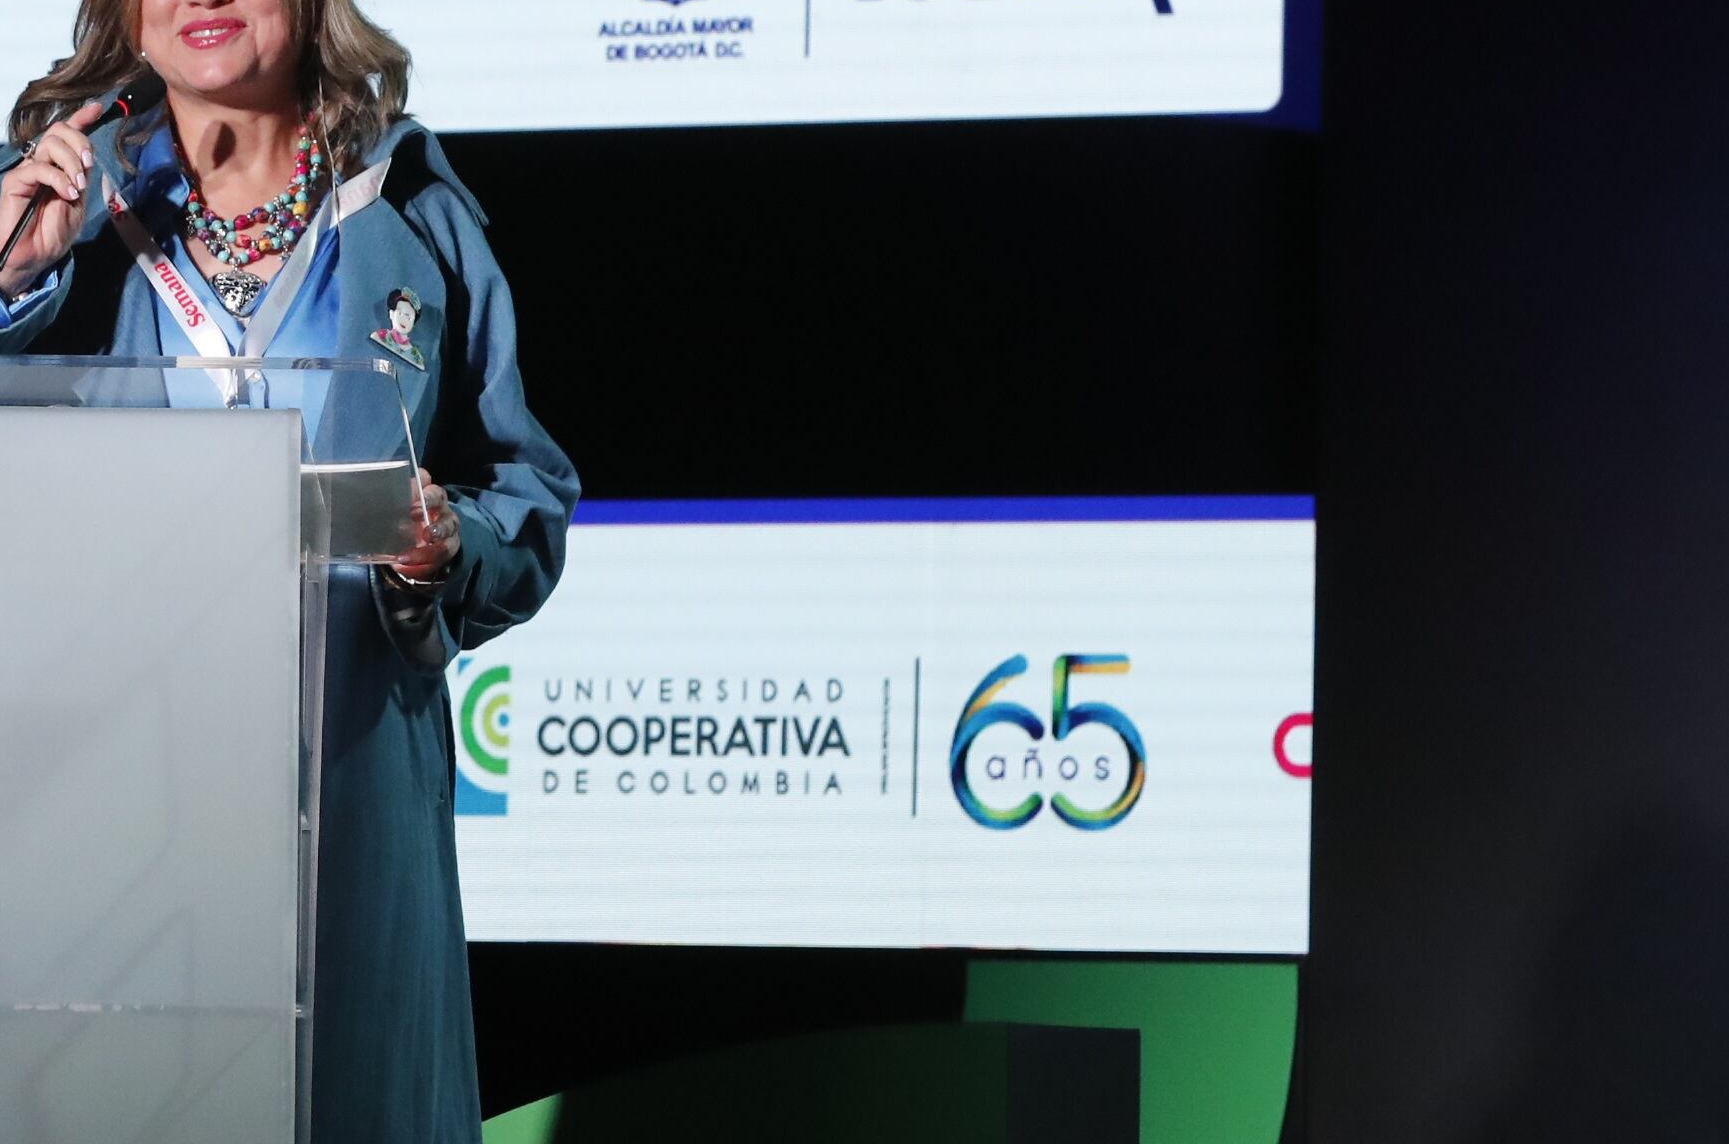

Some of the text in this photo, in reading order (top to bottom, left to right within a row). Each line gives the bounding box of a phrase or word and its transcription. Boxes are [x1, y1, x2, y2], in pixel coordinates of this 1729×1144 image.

[691, 17, 754, 35] MAYOR
[606, 44, 628, 61] DE
[153, 261, 206, 328] Semana
[544, 677, 845, 704] UNIVERSIDAD
[537, 715, 852, 758] COOPERATIVA
[949, 653, 1147, 832] 65
[984, 745, 1111, 783] años
[542, 768, 843, 796] DE COLOMBIA
